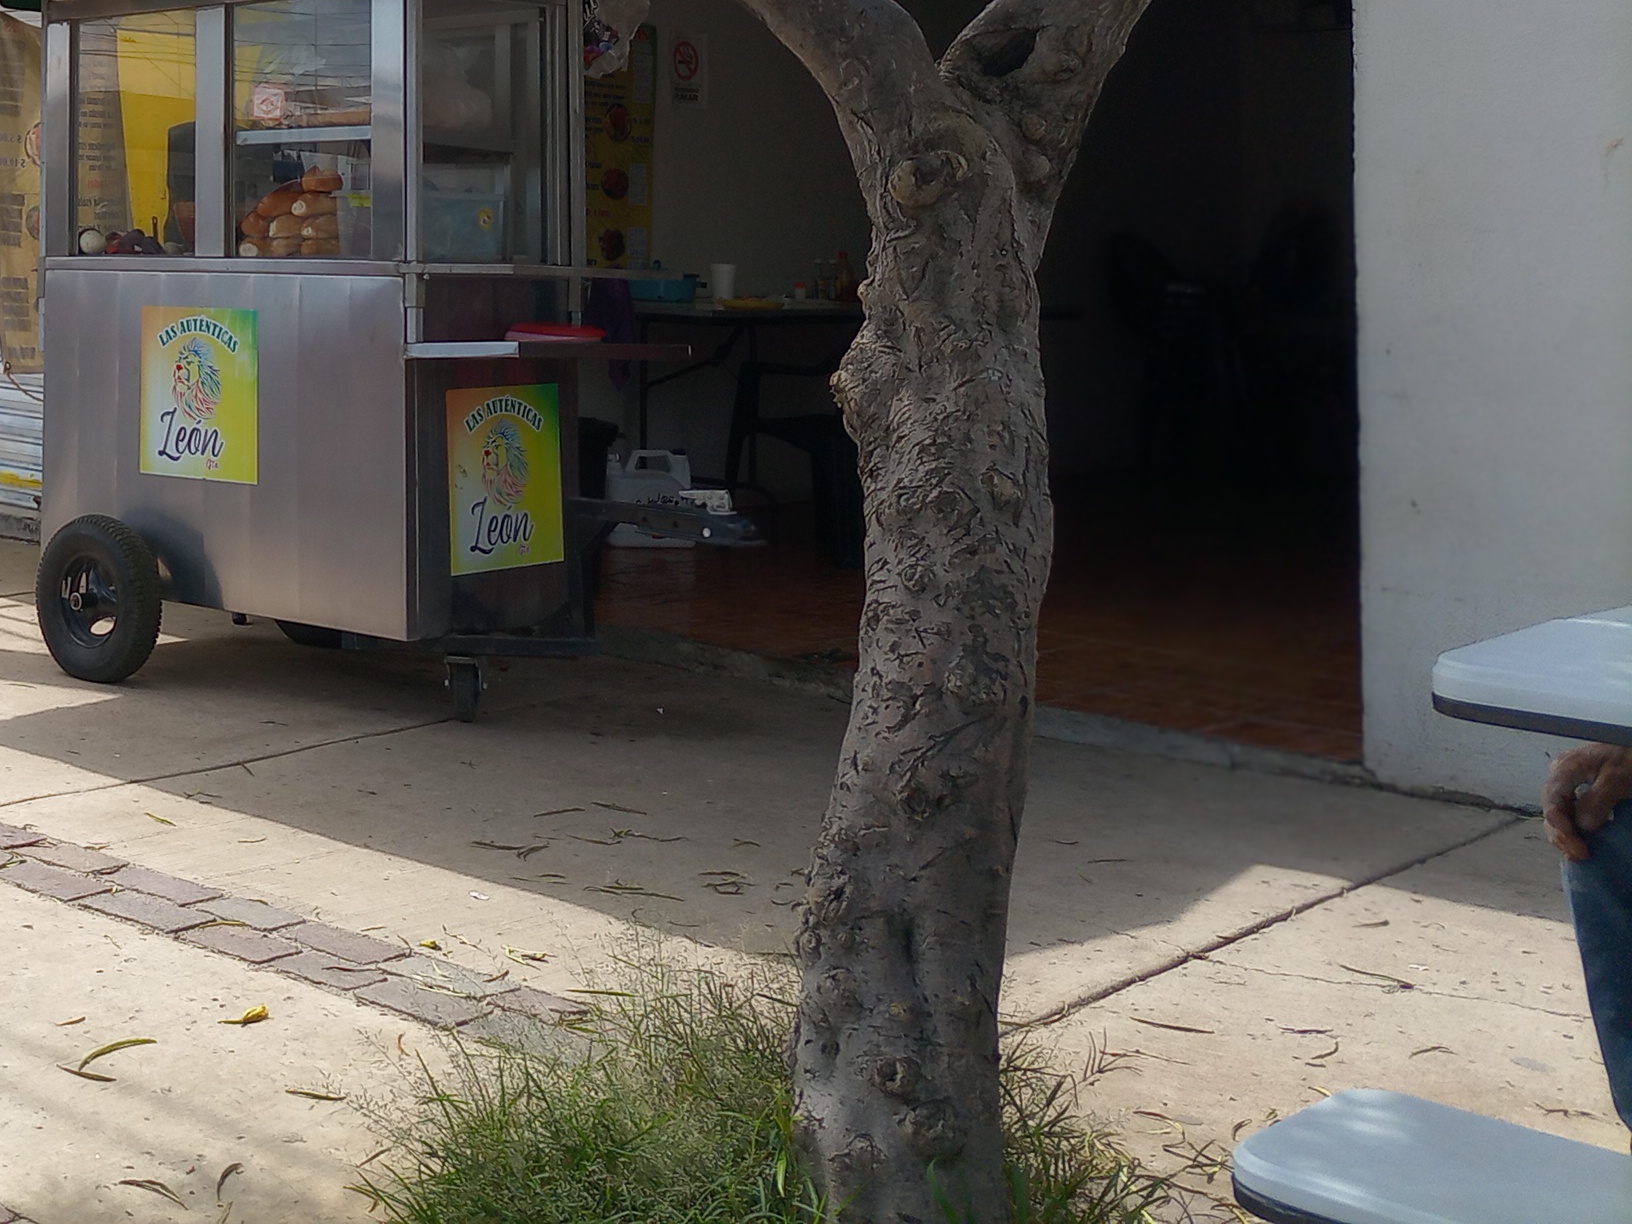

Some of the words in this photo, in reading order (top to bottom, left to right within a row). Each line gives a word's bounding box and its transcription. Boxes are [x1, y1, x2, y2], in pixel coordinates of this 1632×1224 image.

[158, 325, 178, 347] LAS
[180, 315, 239, 353] AUTÉNTICAS
[158, 407, 224, 462] León
[465, 408, 485, 433] LAS
[485, 395, 543, 431] AUTÉNTICAS
[470, 495, 535, 555] León
